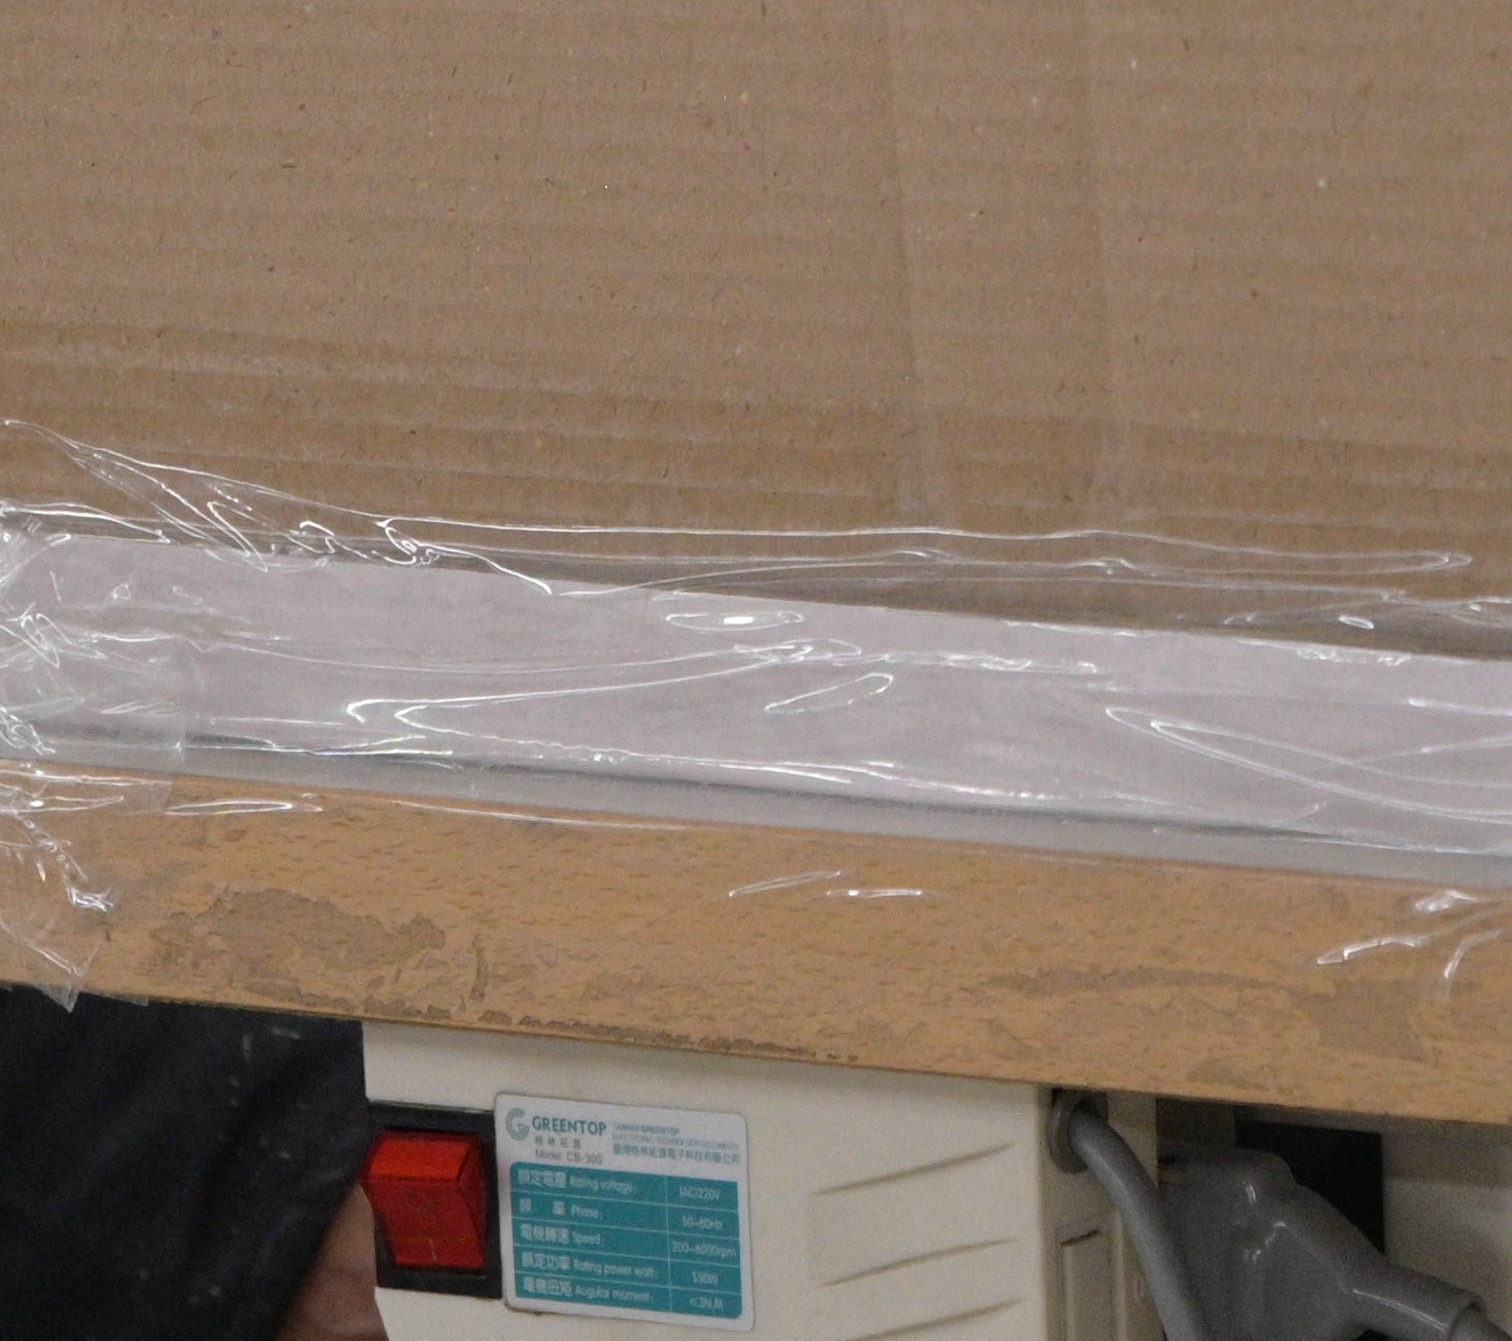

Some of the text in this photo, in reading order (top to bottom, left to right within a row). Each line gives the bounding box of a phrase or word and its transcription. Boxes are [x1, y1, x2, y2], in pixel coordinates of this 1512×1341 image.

[532, 1116, 607, 1136] GREENTOP
[570, 1175, 598, 1191] Rating
[573, 1258, 602, 1273] Rating
[603, 1264, 632, 1277] power
[692, 1270, 719, 1286] 550W
